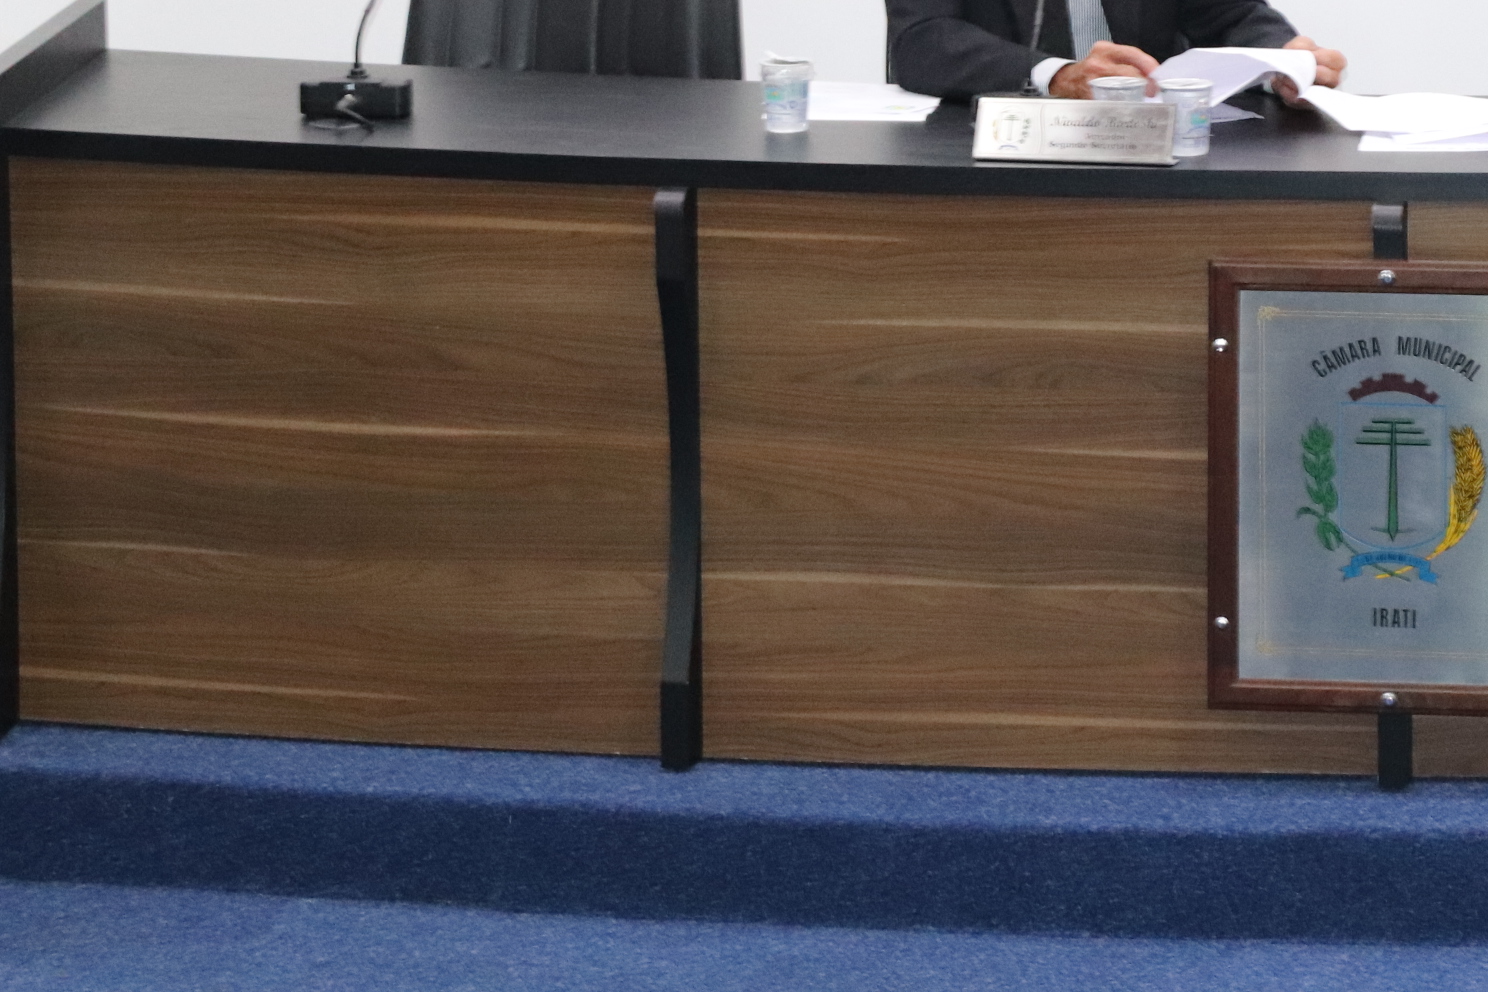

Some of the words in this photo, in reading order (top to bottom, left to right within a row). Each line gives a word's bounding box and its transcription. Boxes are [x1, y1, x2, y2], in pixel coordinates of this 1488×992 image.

[1311, 336, 1382, 378] CÂMARA
[1397, 335, 1482, 382] MUNICIPAL
[1372, 607, 1417, 629] IRATI
